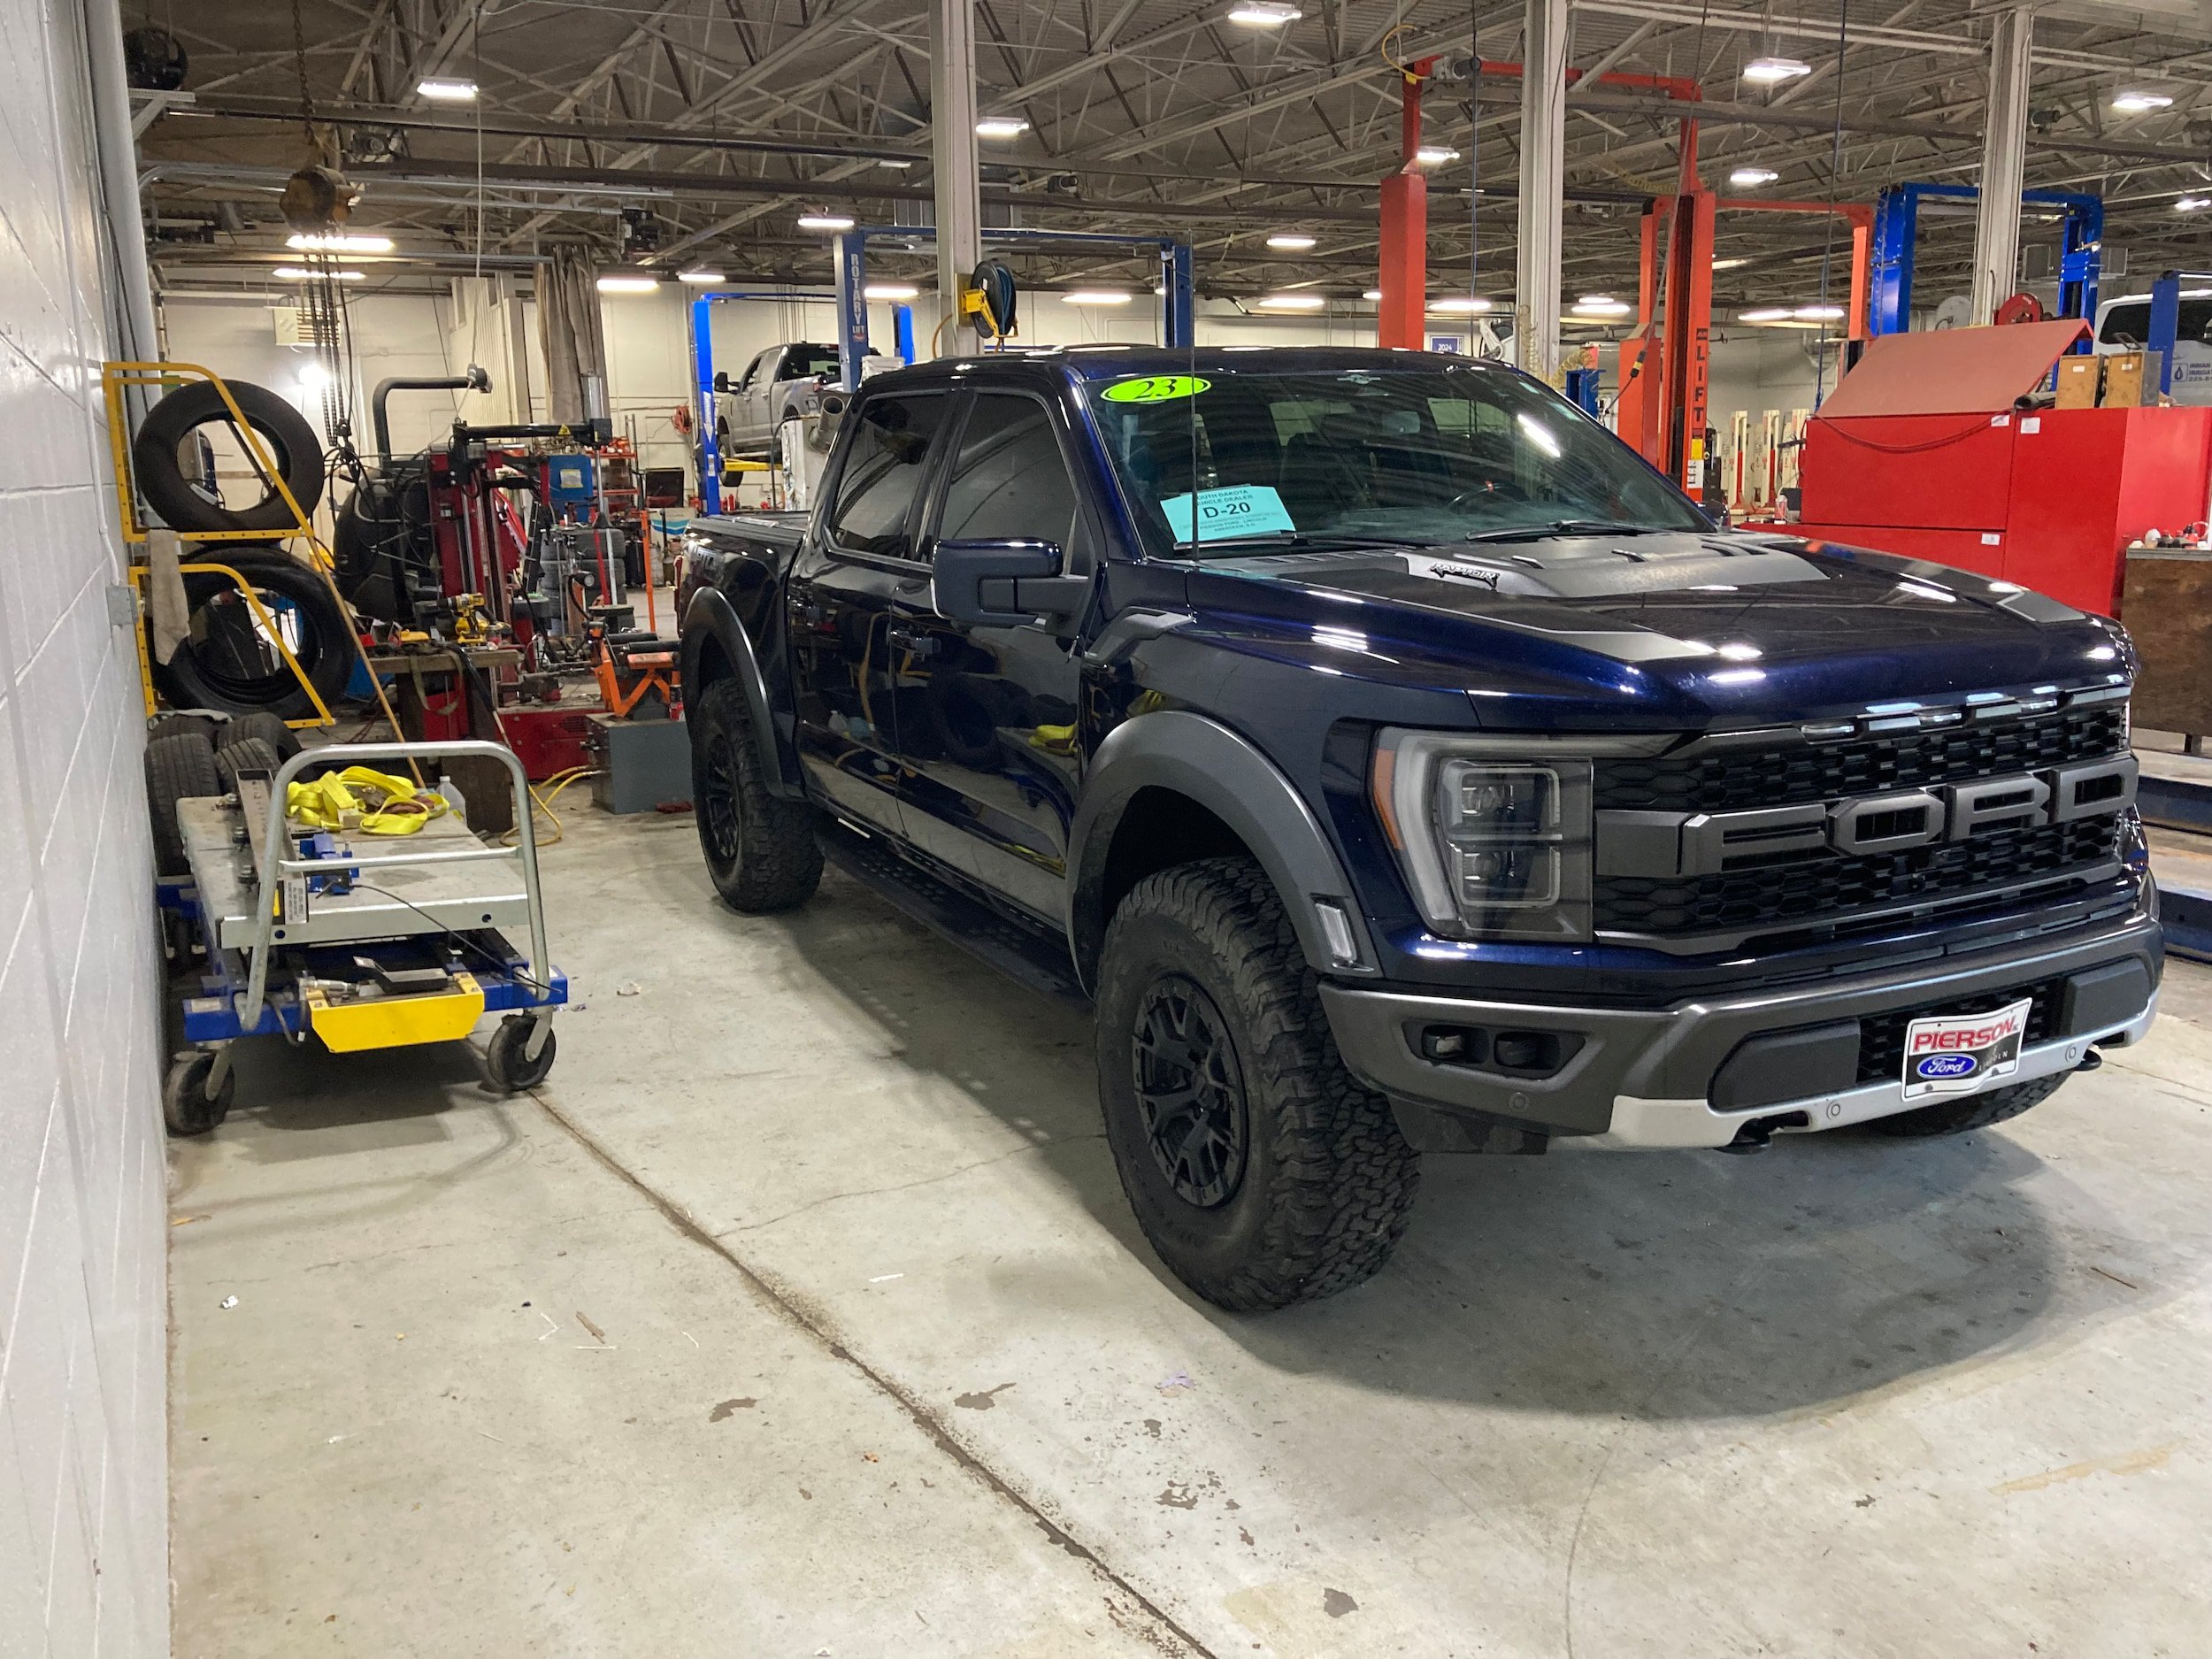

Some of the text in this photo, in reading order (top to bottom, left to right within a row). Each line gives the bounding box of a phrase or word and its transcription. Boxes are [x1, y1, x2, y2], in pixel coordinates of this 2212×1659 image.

[850, 253, 862, 325] ROTARY
[1133, 379, 1177, 399] 23
[1694, 345, 1705, 422] LIFT
[1203, 502, 1251, 518] D-20
[1429, 563, 1501, 588] RAPTOR
[1682, 754, 2139, 878] FORD
[1913, 1016, 2016, 1053] PIERSON
[1927, 1056, 1965, 1074] Ford
